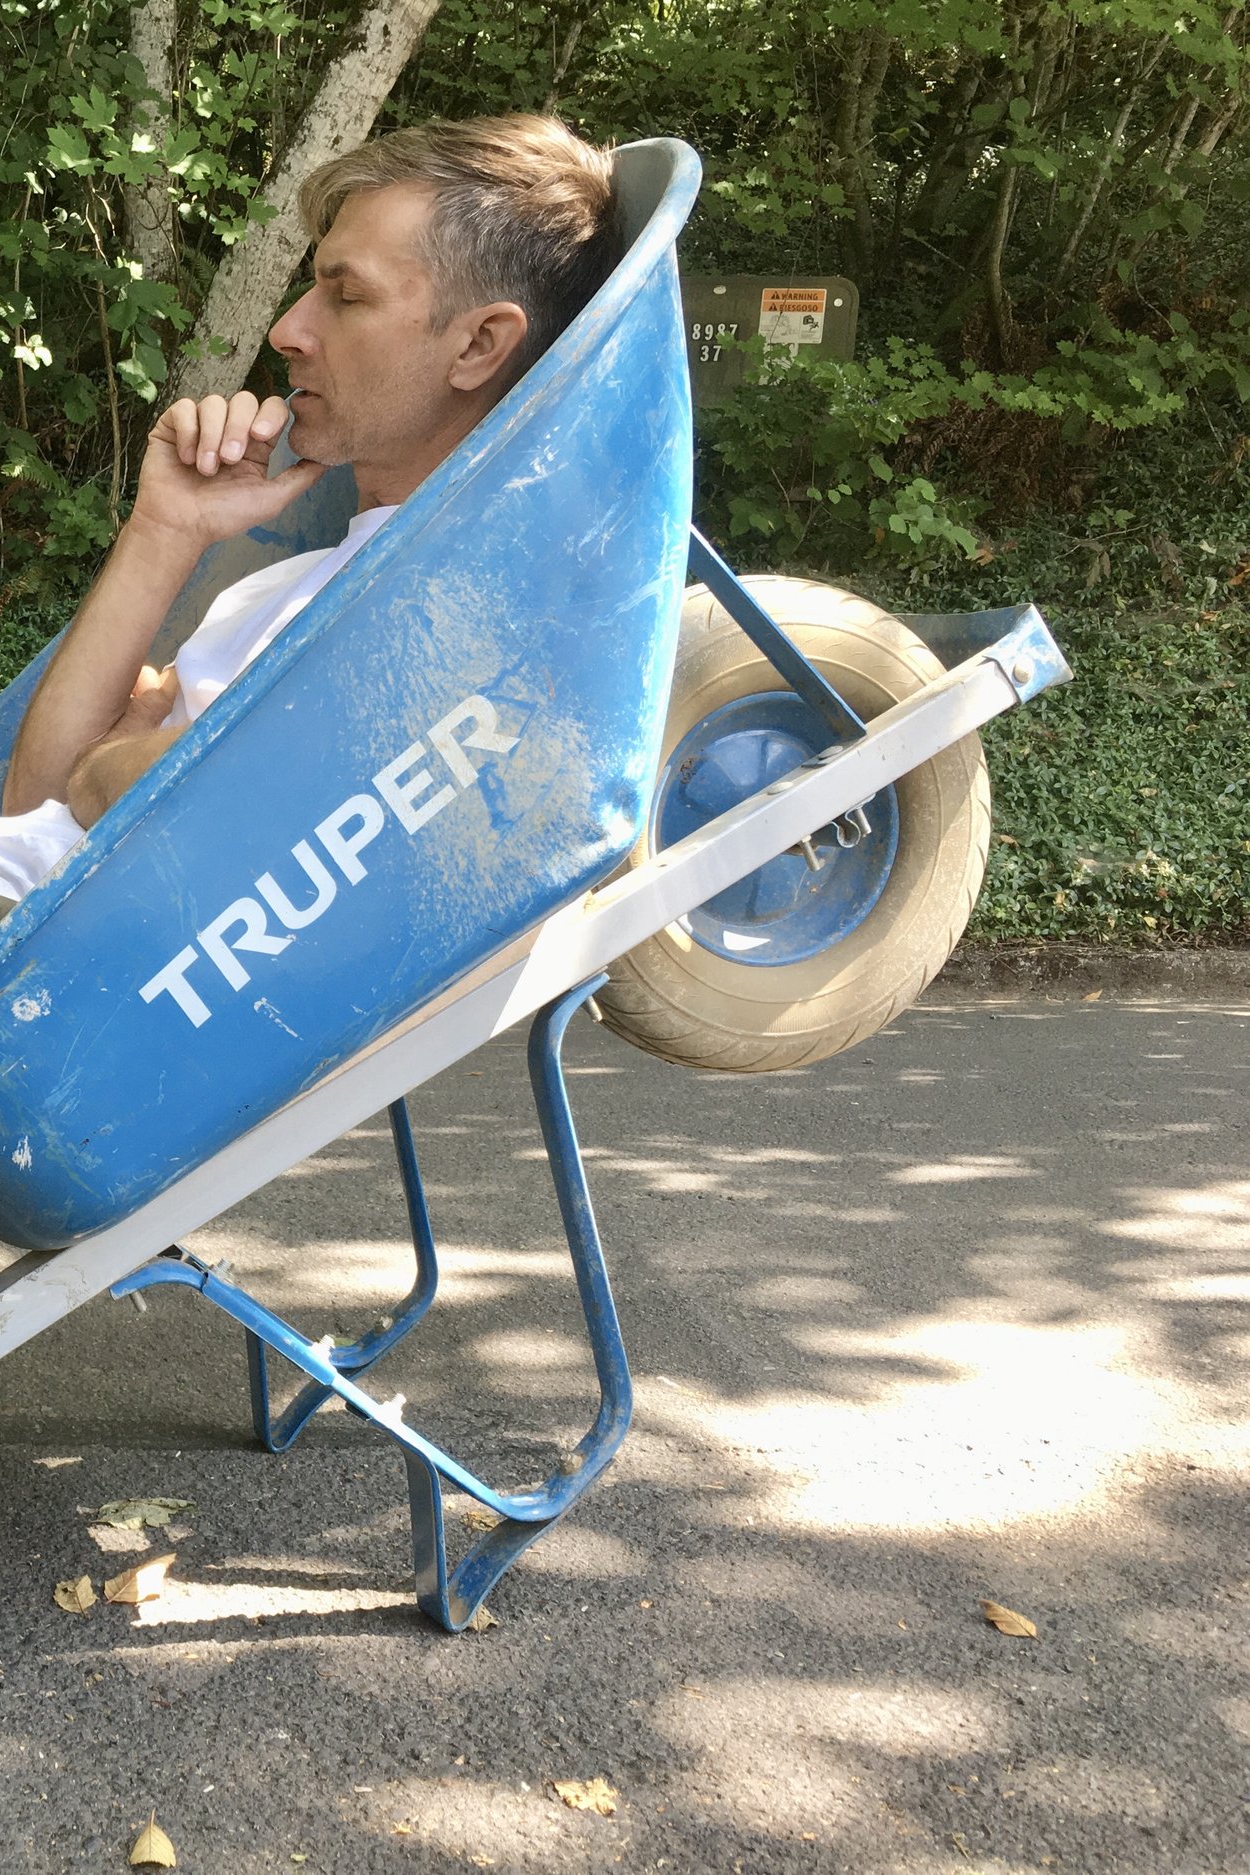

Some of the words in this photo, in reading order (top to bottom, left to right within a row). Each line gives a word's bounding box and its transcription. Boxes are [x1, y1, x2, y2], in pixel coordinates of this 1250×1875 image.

[781, 292, 818, 300] WARNING
[779, 304, 818, 312] RIESGOSO
[700, 345, 722, 362] 37
[138, 694, 521, 1029] TRUPER
